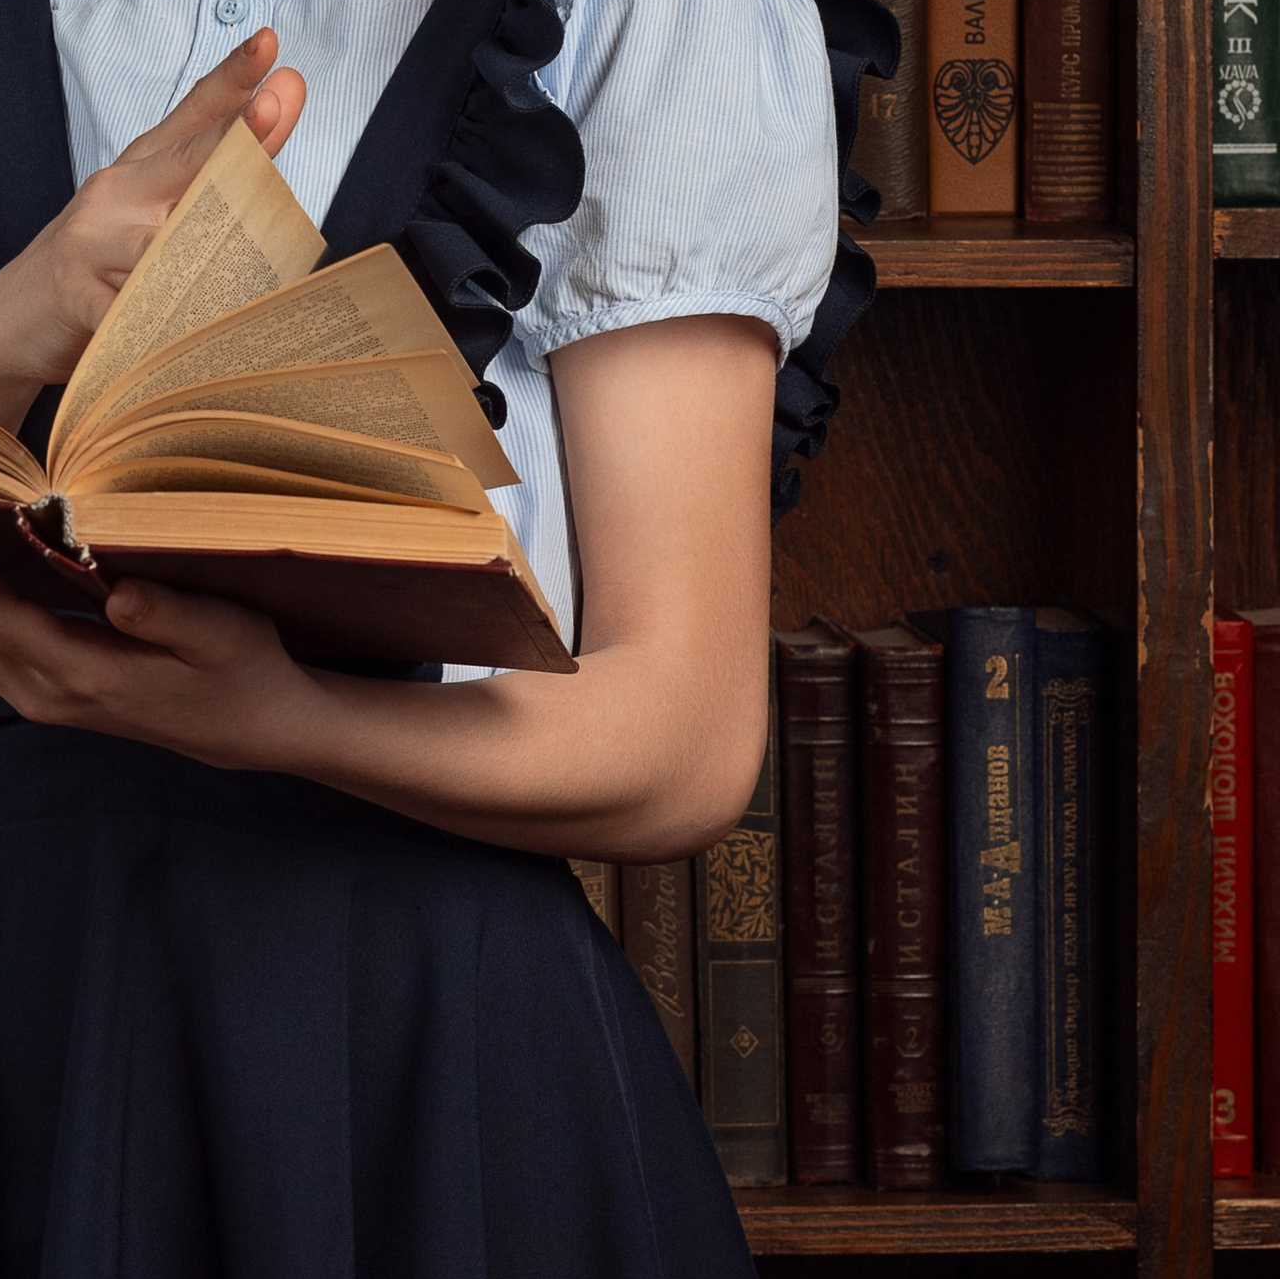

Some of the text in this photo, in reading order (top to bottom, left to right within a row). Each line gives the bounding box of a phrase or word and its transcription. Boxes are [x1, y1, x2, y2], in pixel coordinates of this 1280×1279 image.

[1059, 50, 1080, 99] КУРС
[1218, 65, 1260, 81] SLAVIA
[868, 92, 898, 119] 17
[985, 654, 1011, 700] 2
[1212, 671, 1239, 963] МИХАИЛ ШОЛОХОВ
[907, 1024, 919, 1049] 2
[1213, 1087, 1236, 1123] 3
